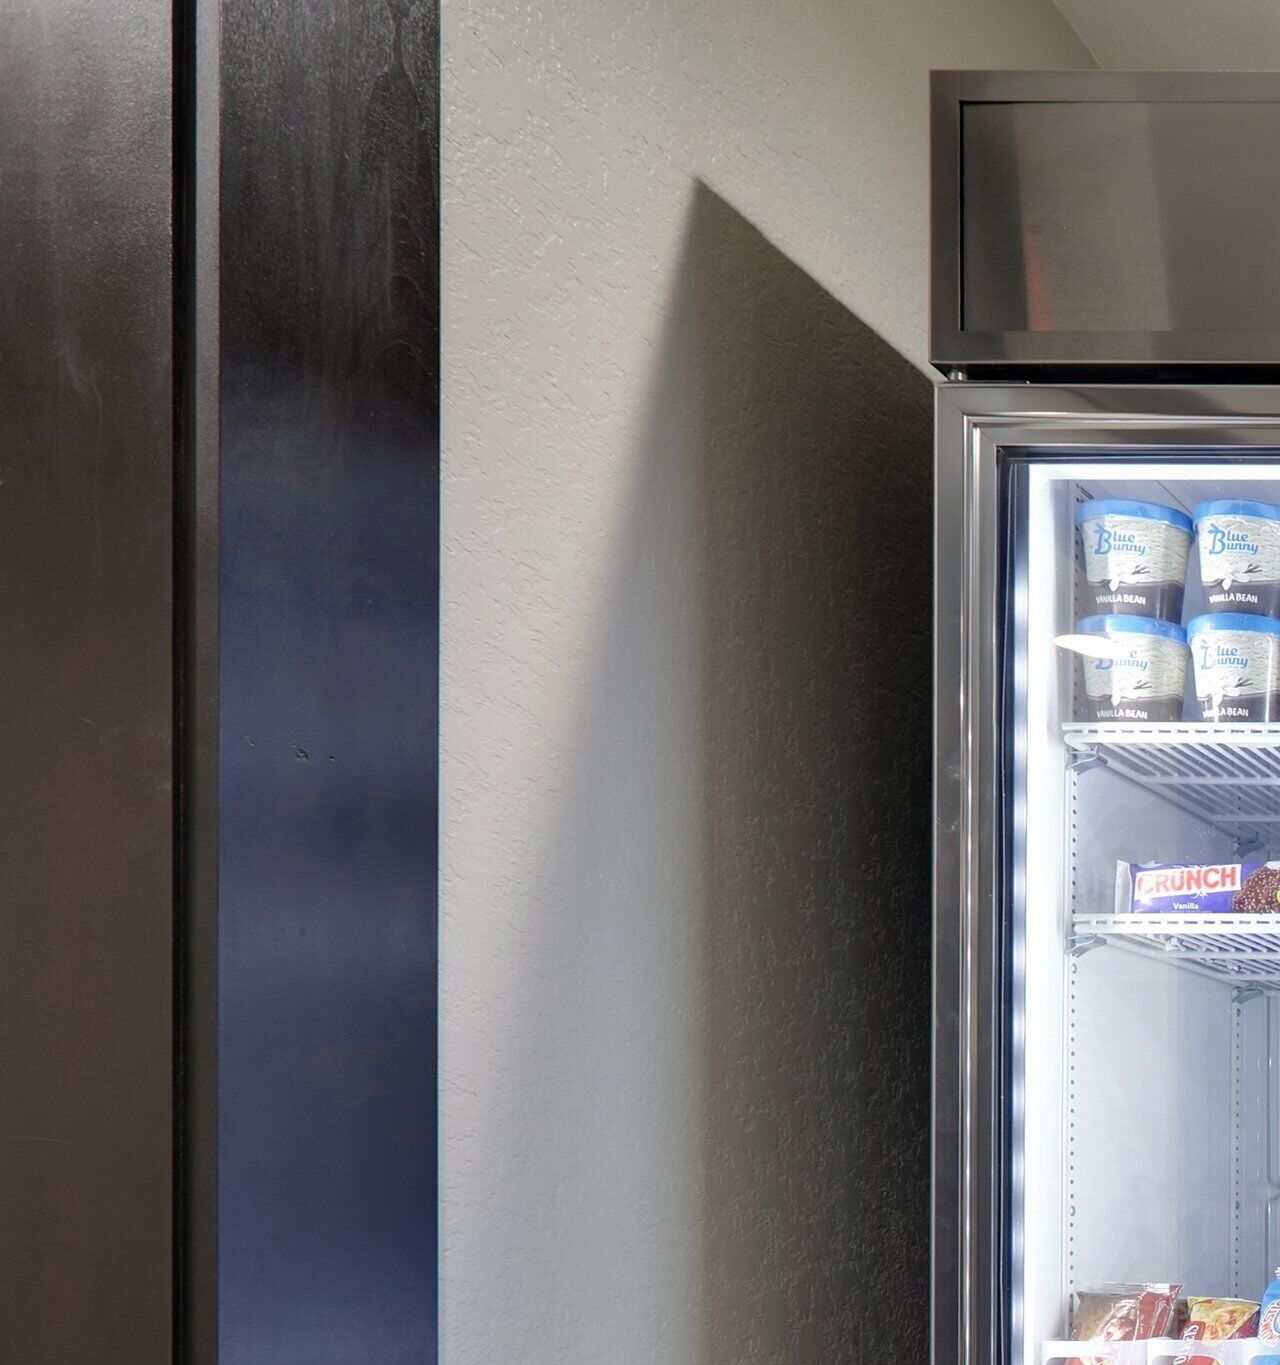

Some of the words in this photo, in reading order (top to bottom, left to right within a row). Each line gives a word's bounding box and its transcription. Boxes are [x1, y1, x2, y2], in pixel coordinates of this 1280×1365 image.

[1095, 594, 1123, 605] VANILLA
[1123, 594, 1147, 605] BEAN
[1208, 593, 1235, 604] VANILLA
[1235, 592, 1258, 604] BEAN
[1096, 708, 1124, 719] VANILLA
[1124, 708, 1147, 719] BEAN
[1228, 707, 1249, 718] BEAN
[1138, 866, 1237, 894] CRUNCH
[1173, 901, 1199, 910] Vanilla
